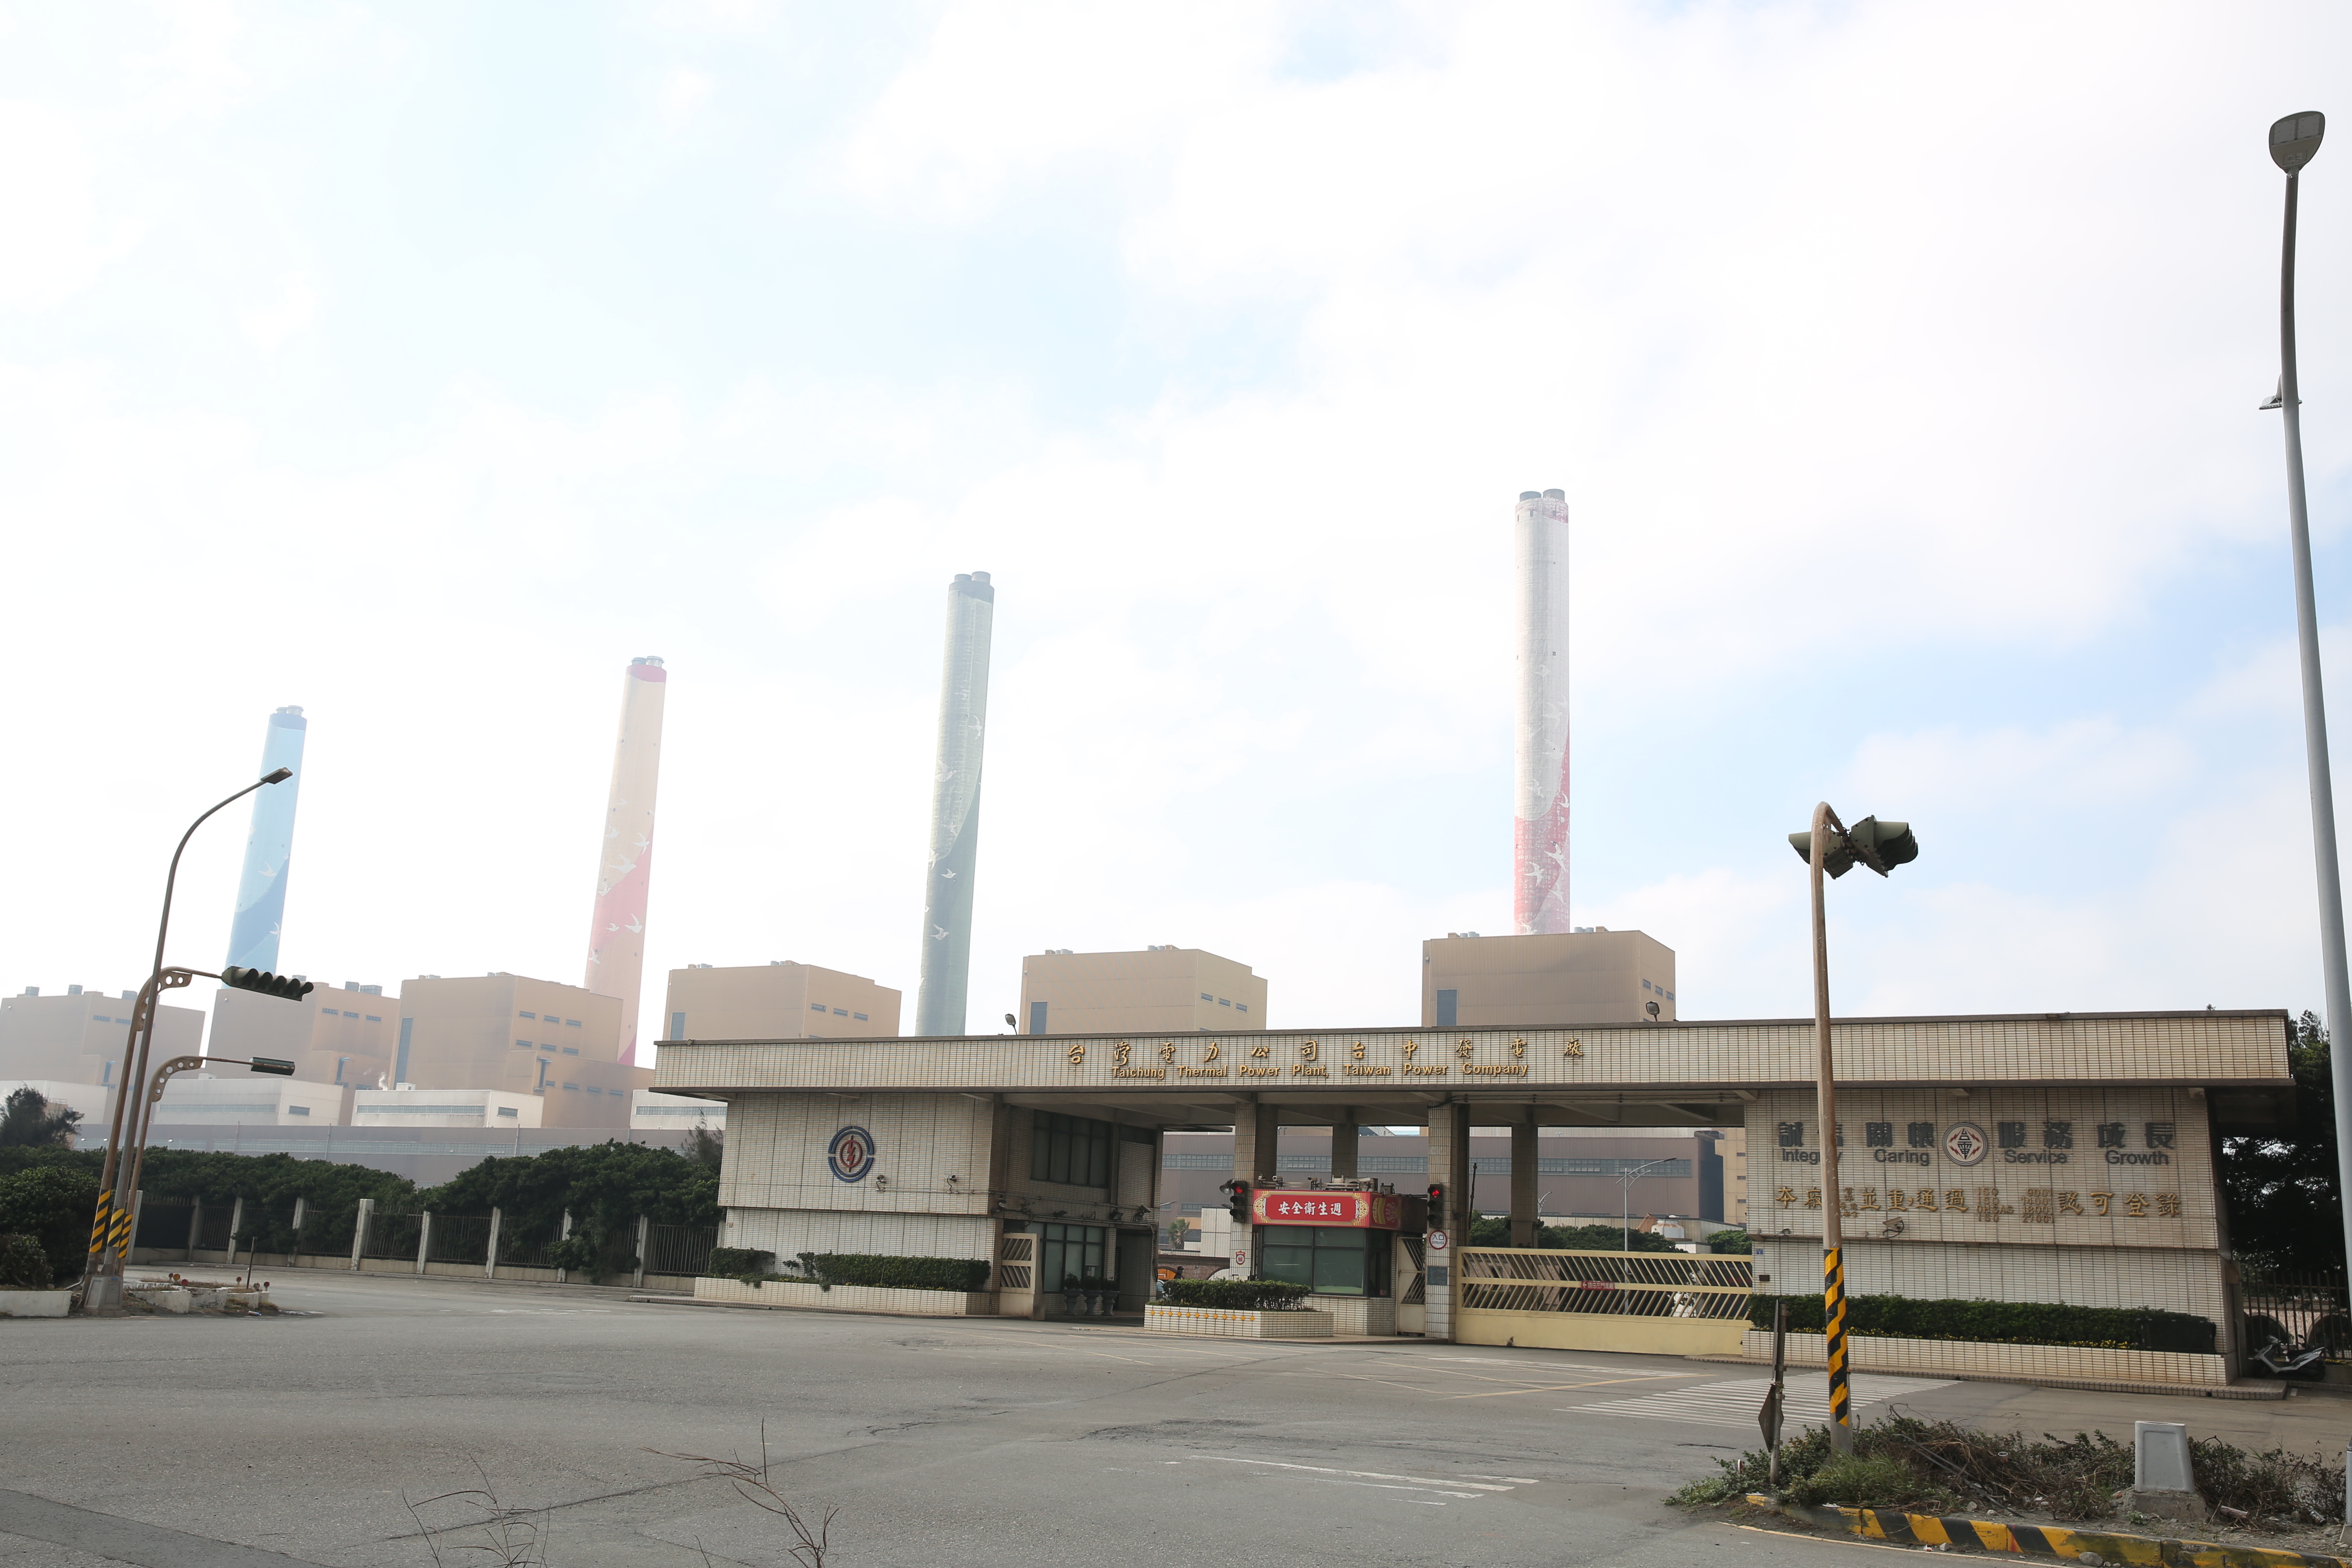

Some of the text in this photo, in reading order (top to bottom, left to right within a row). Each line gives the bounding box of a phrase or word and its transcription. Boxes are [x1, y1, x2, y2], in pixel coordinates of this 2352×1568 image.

[1112, 1062, 1528, 1080] Taichung Thermal Power Plant, Taiwan Power Company
[1865, 1121, 1935, 1148] 關懷
[1997, 1121, 2072, 1149] 服務
[2097, 1122, 2175, 1149] 成長
[1873, 1148, 1929, 1166] Caring
[2005, 1149, 2068, 1164] Service
[2105, 1149, 2169, 1165] Growth
[2027, 1188, 2052, 1197] 9001
[1978, 1196, 2053, 1205] ISO 14001
[2058, 1191, 2181, 1218] 認可登錄
[1278, 1201, 1342, 1216] 安全衛生週
[1977, 1205, 2053, 1214] OHSAS 18001
[1978, 1214, 2054, 1223] ISO 27001
